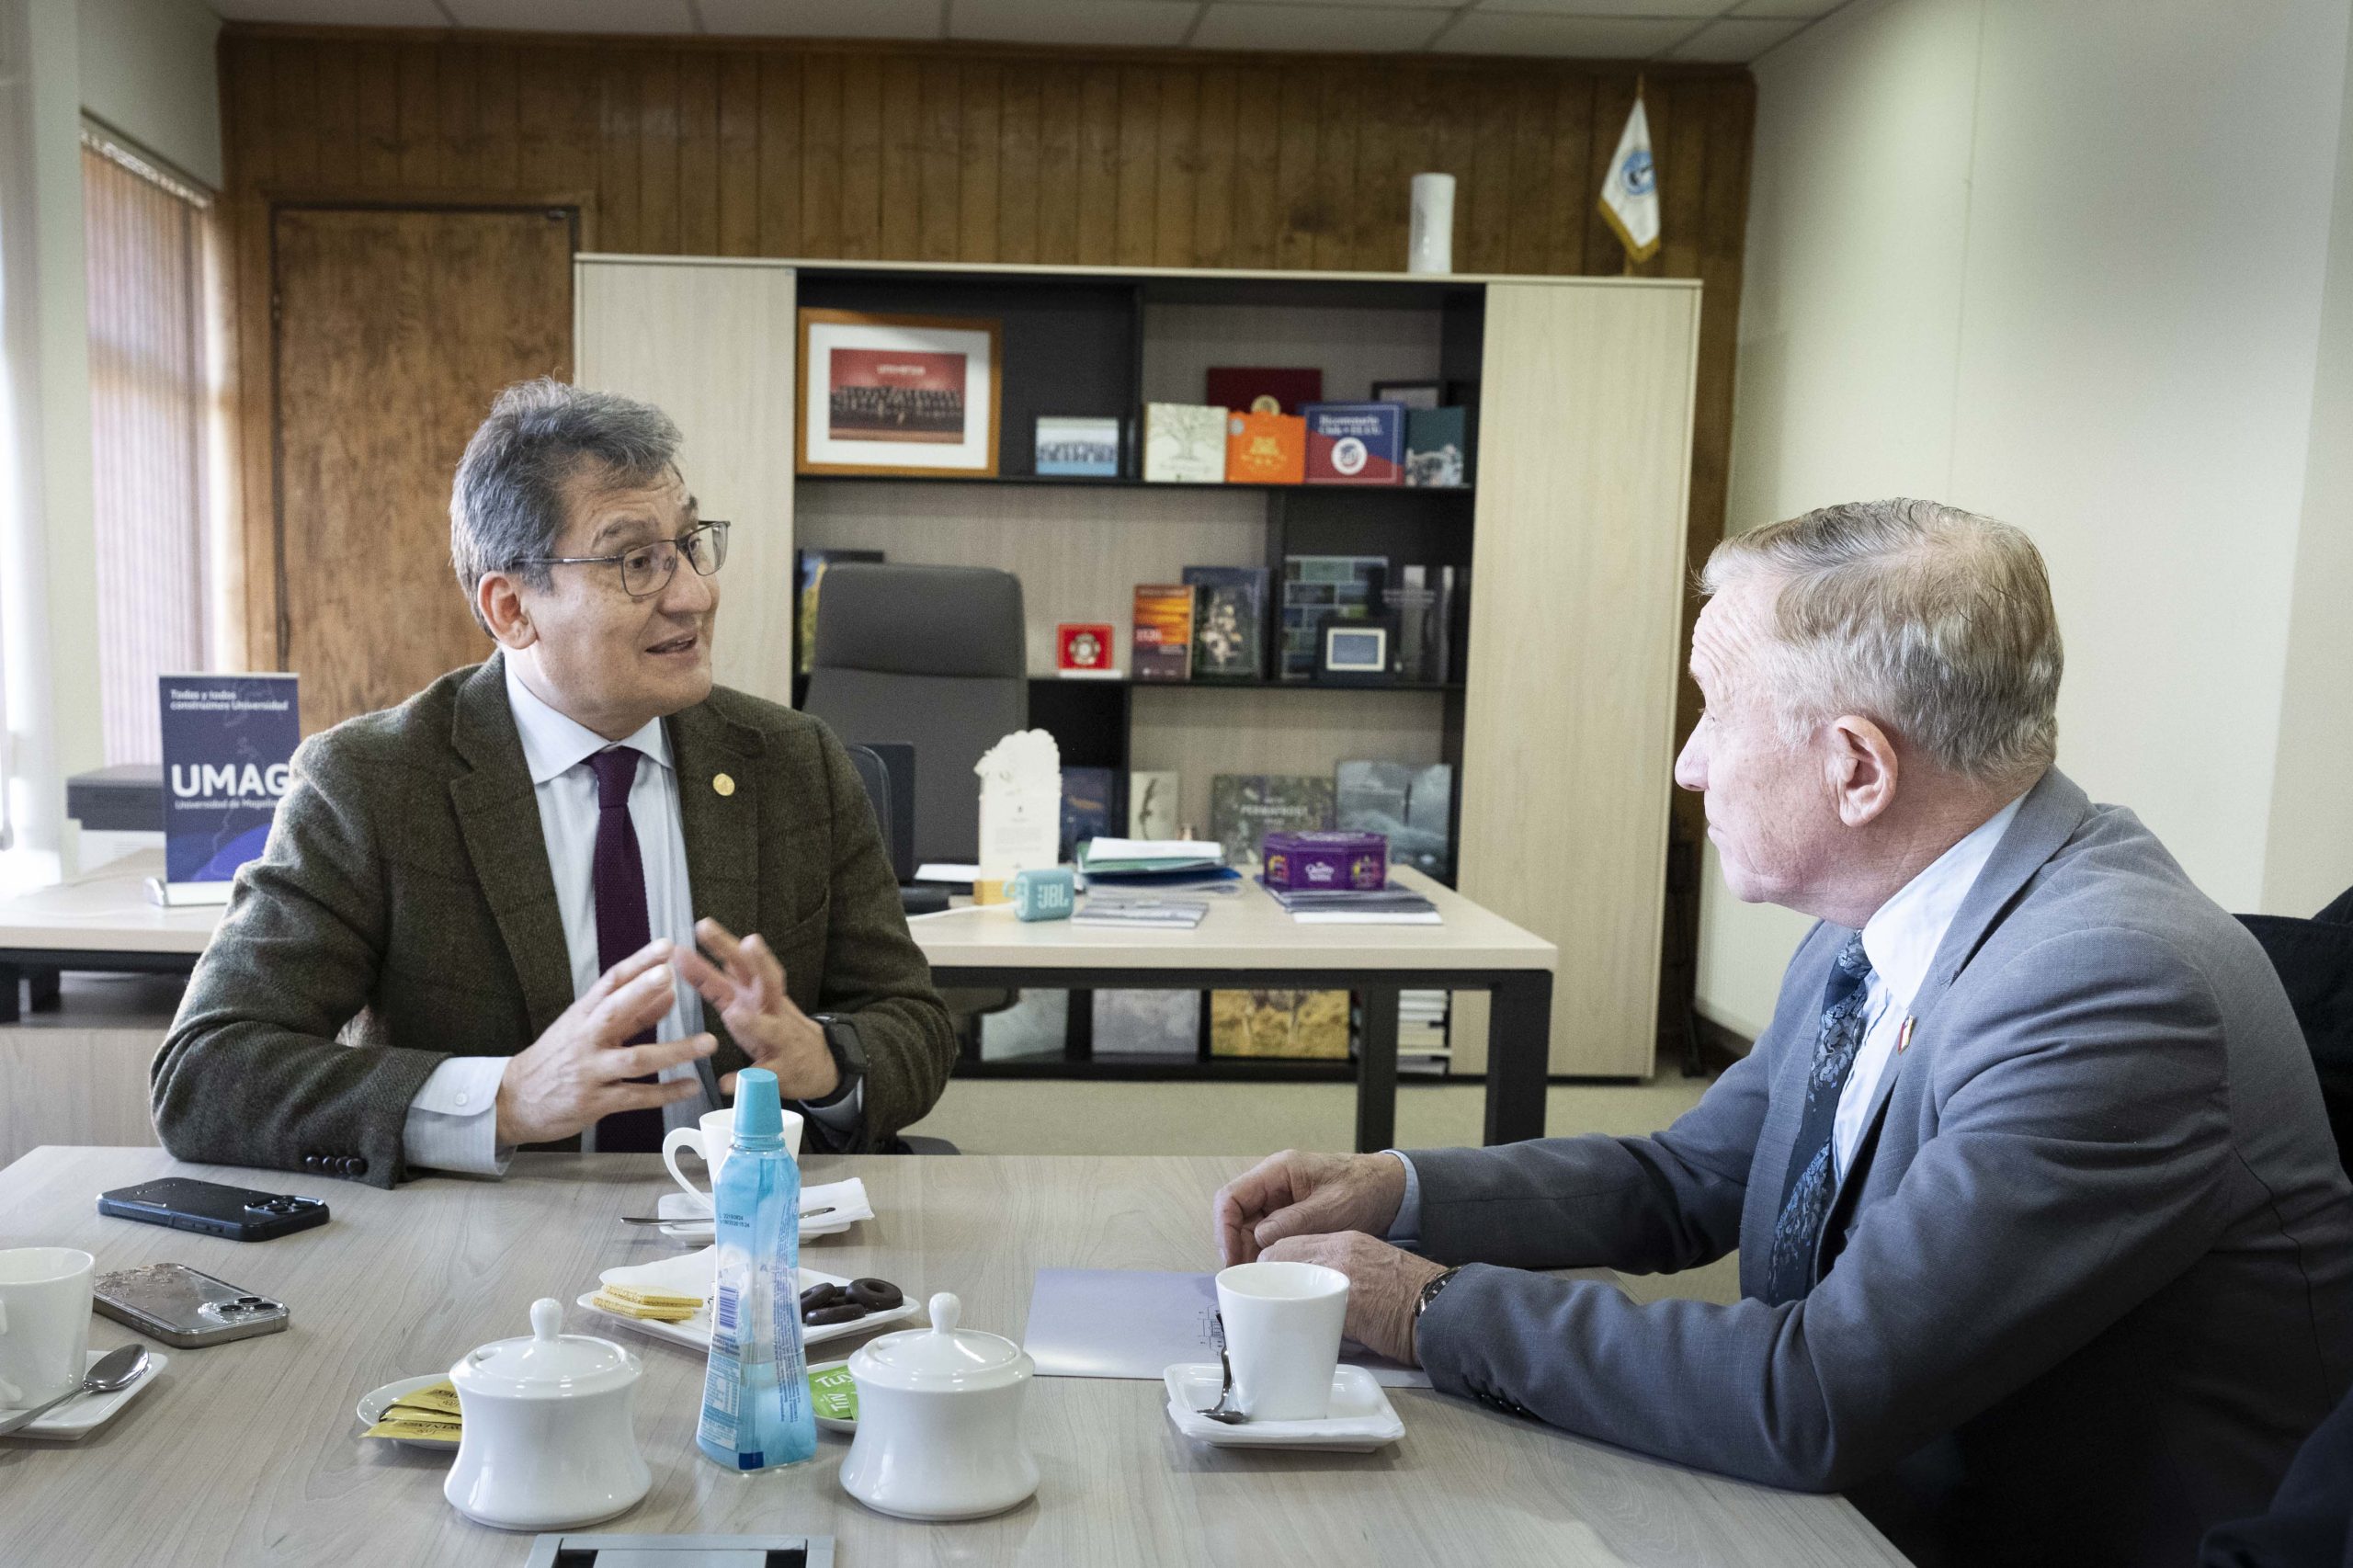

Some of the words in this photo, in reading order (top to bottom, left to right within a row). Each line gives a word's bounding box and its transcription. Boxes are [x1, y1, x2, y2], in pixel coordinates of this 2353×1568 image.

[231, 699, 289, 711] Universidad
[171, 763, 290, 798] UMAG
[1038, 883, 1069, 909] JBL
